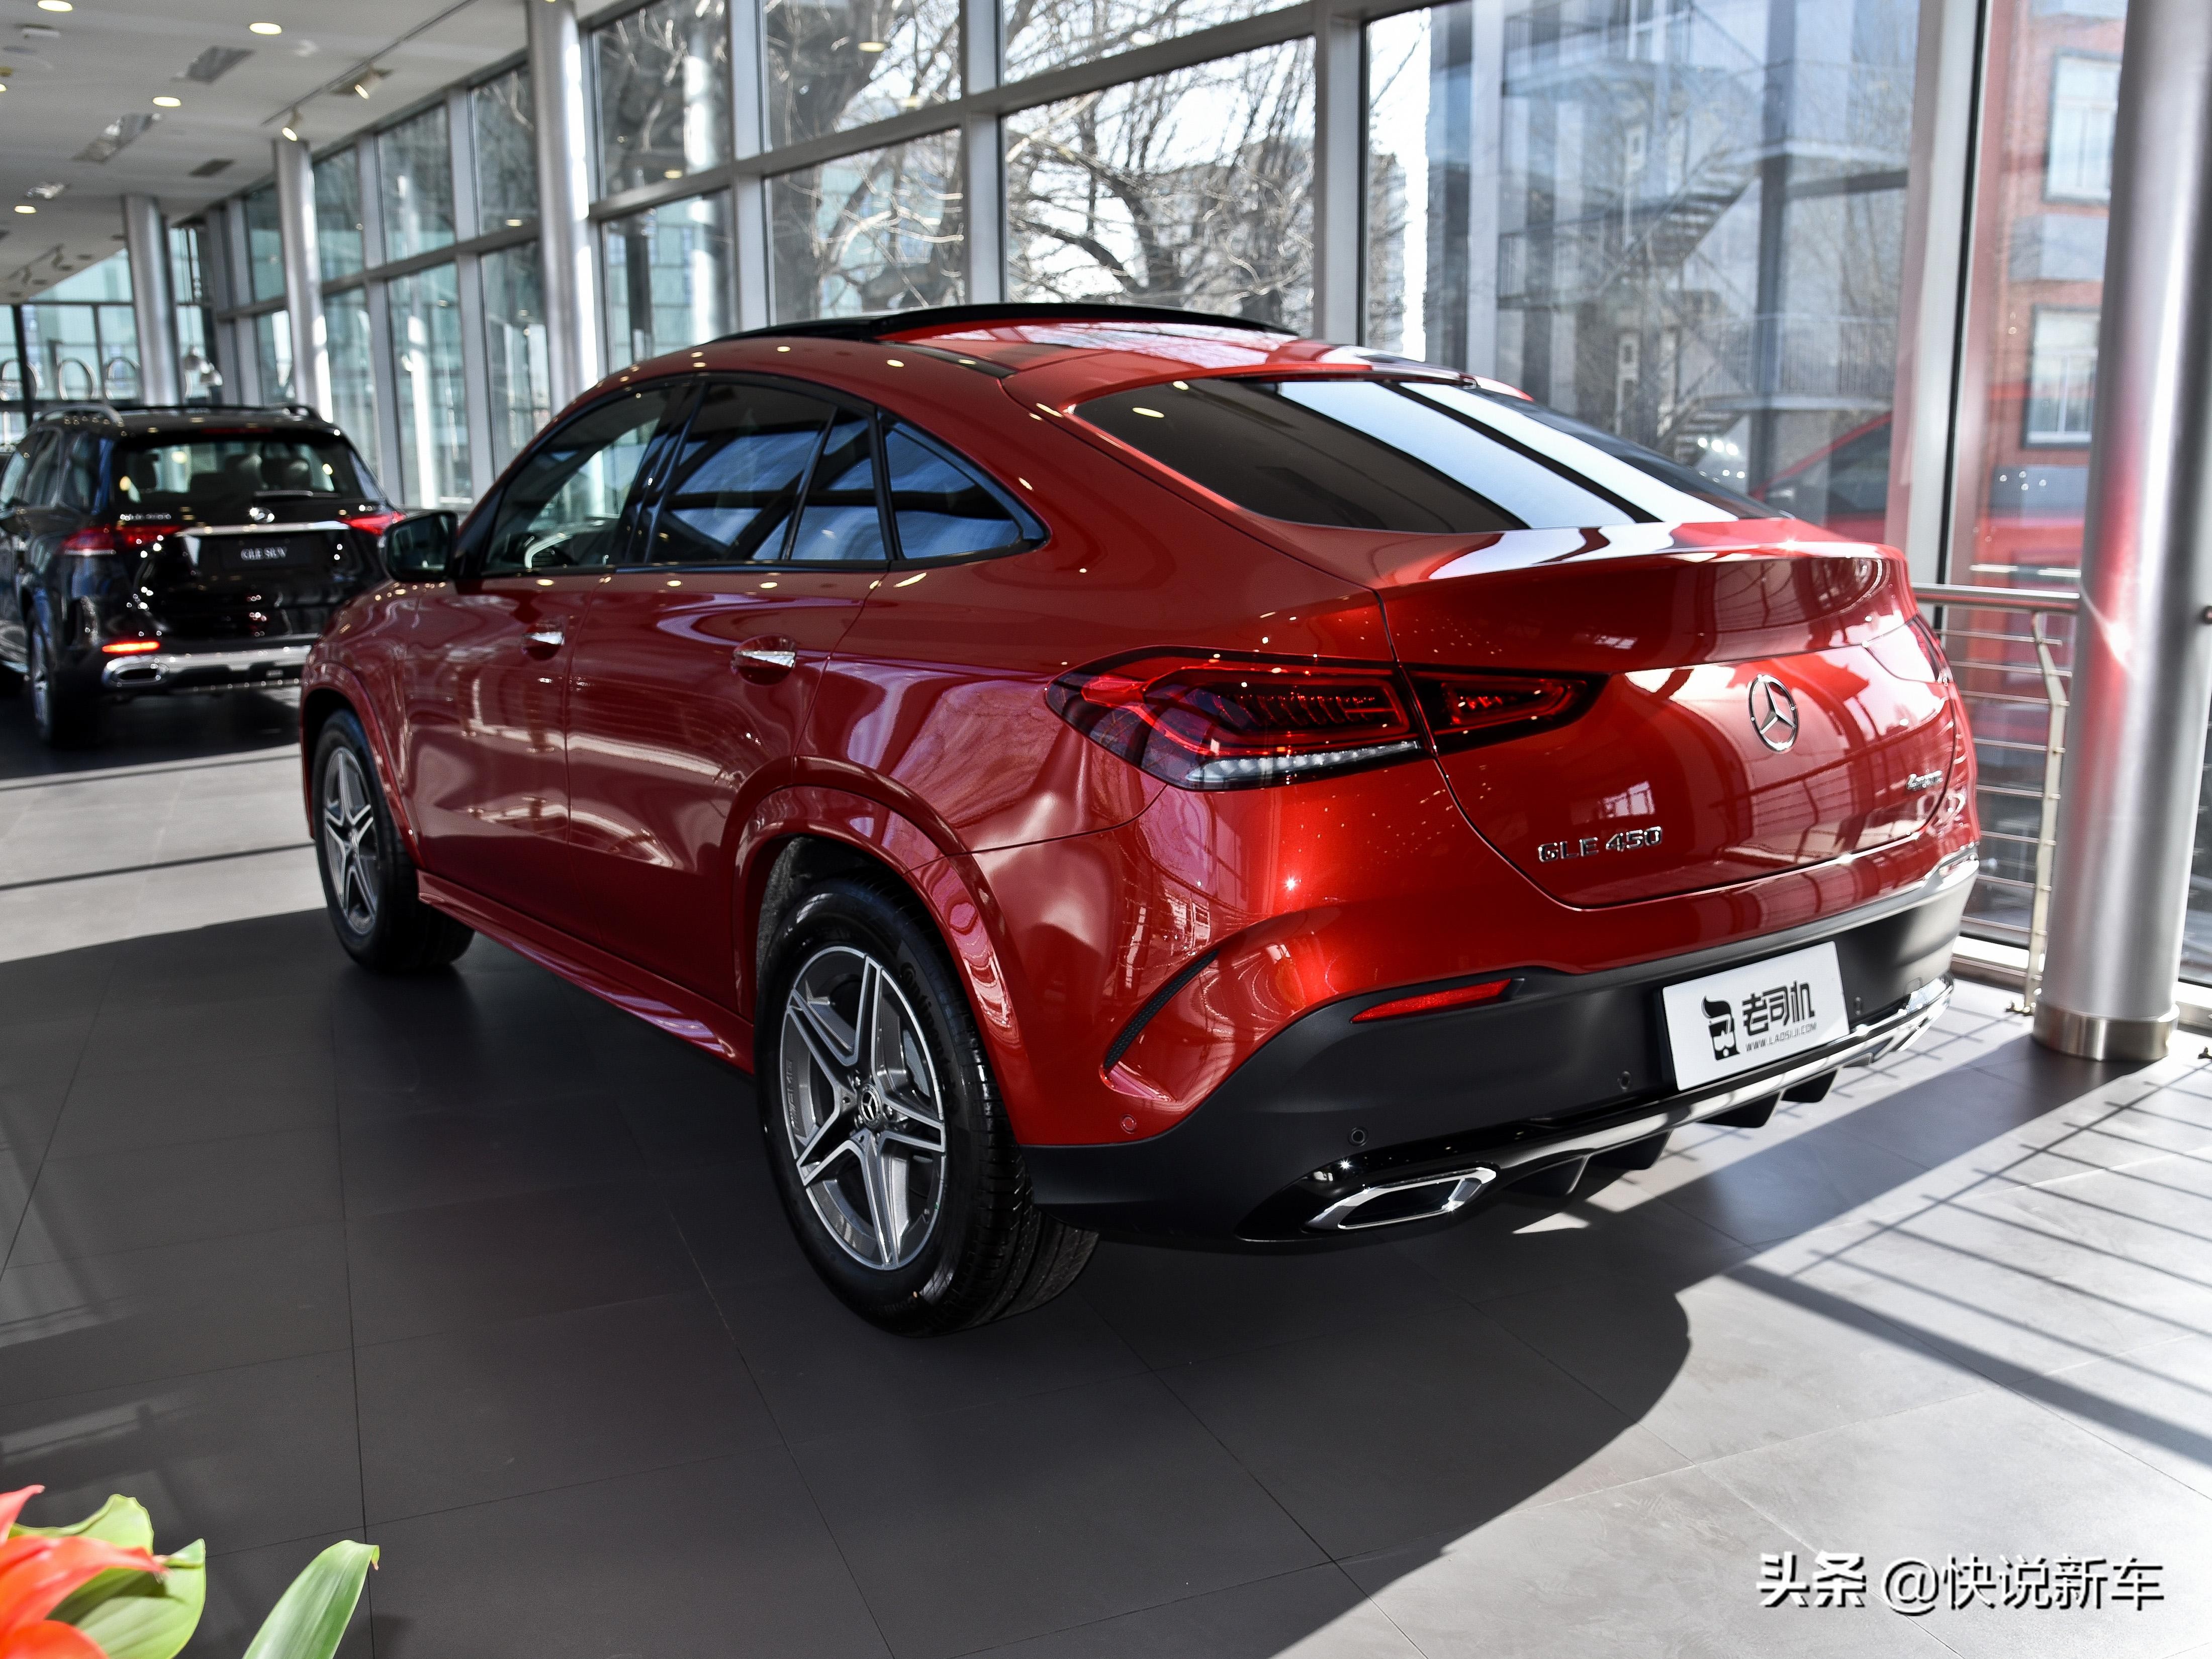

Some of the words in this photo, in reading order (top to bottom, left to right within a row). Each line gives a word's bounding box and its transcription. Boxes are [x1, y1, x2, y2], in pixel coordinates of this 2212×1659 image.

[1538, 837, 1599, 863] GLE
[1605, 826, 1663, 852] 450
[1741, 980, 1815, 1036] 老司机
[1745, 1021, 1817, 1052] WWW.LAOSIJI.COM
